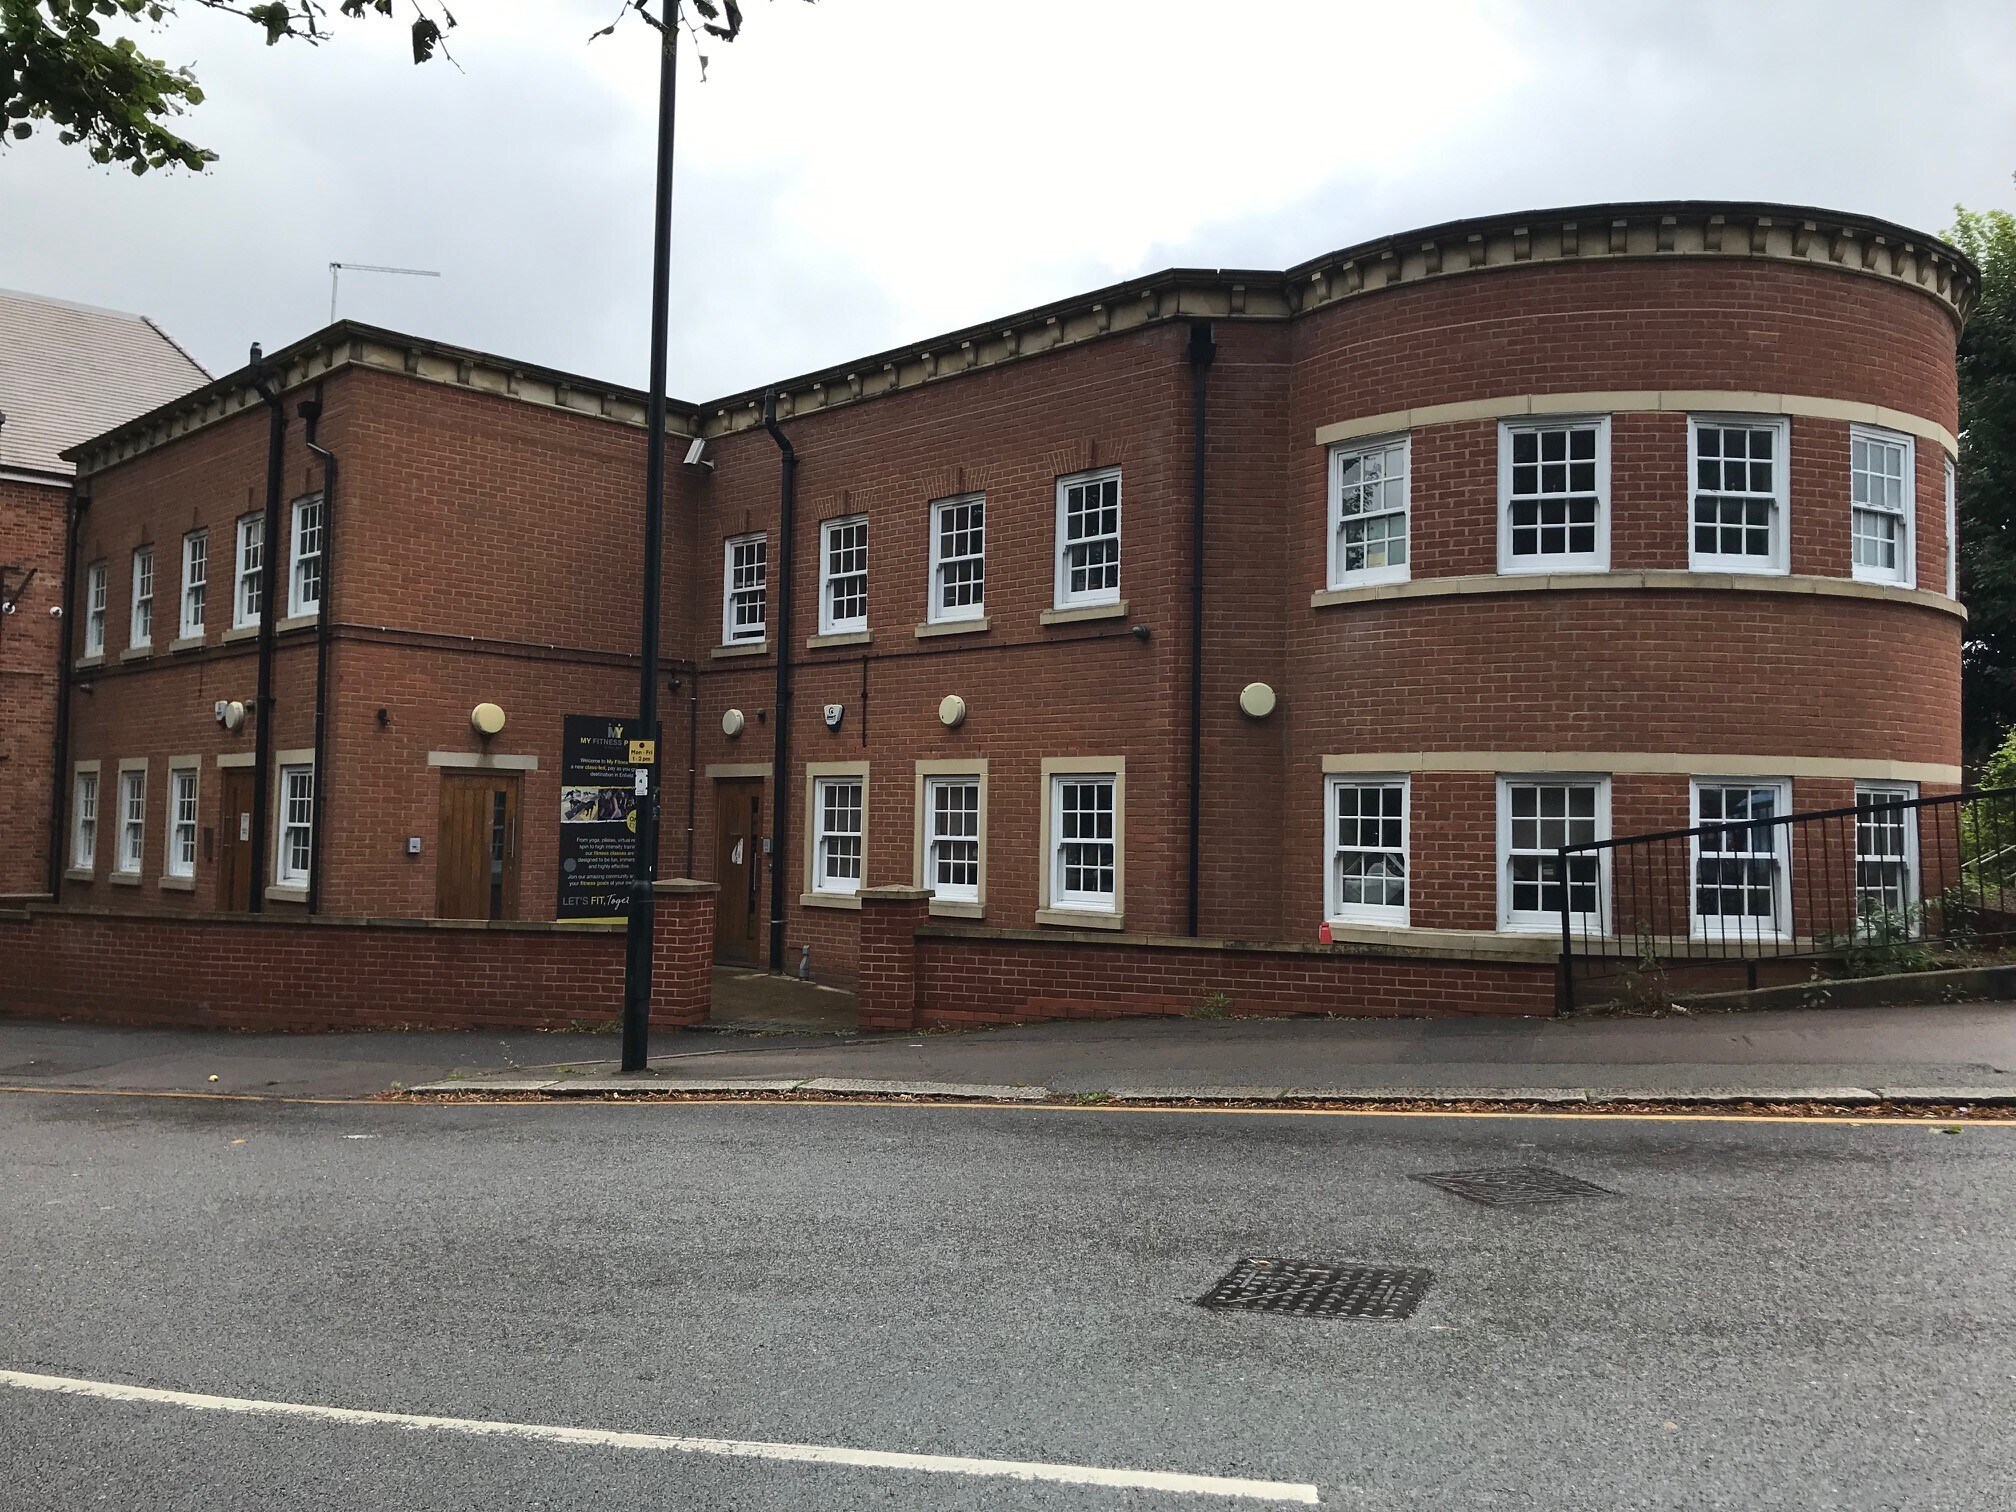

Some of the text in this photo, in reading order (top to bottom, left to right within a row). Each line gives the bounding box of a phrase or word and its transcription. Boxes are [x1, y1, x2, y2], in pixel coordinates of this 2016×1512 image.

[593, 738, 622, 746] FITNESS
[562, 896, 588, 906] LET'S
[591, 896, 606, 906] FIT,
